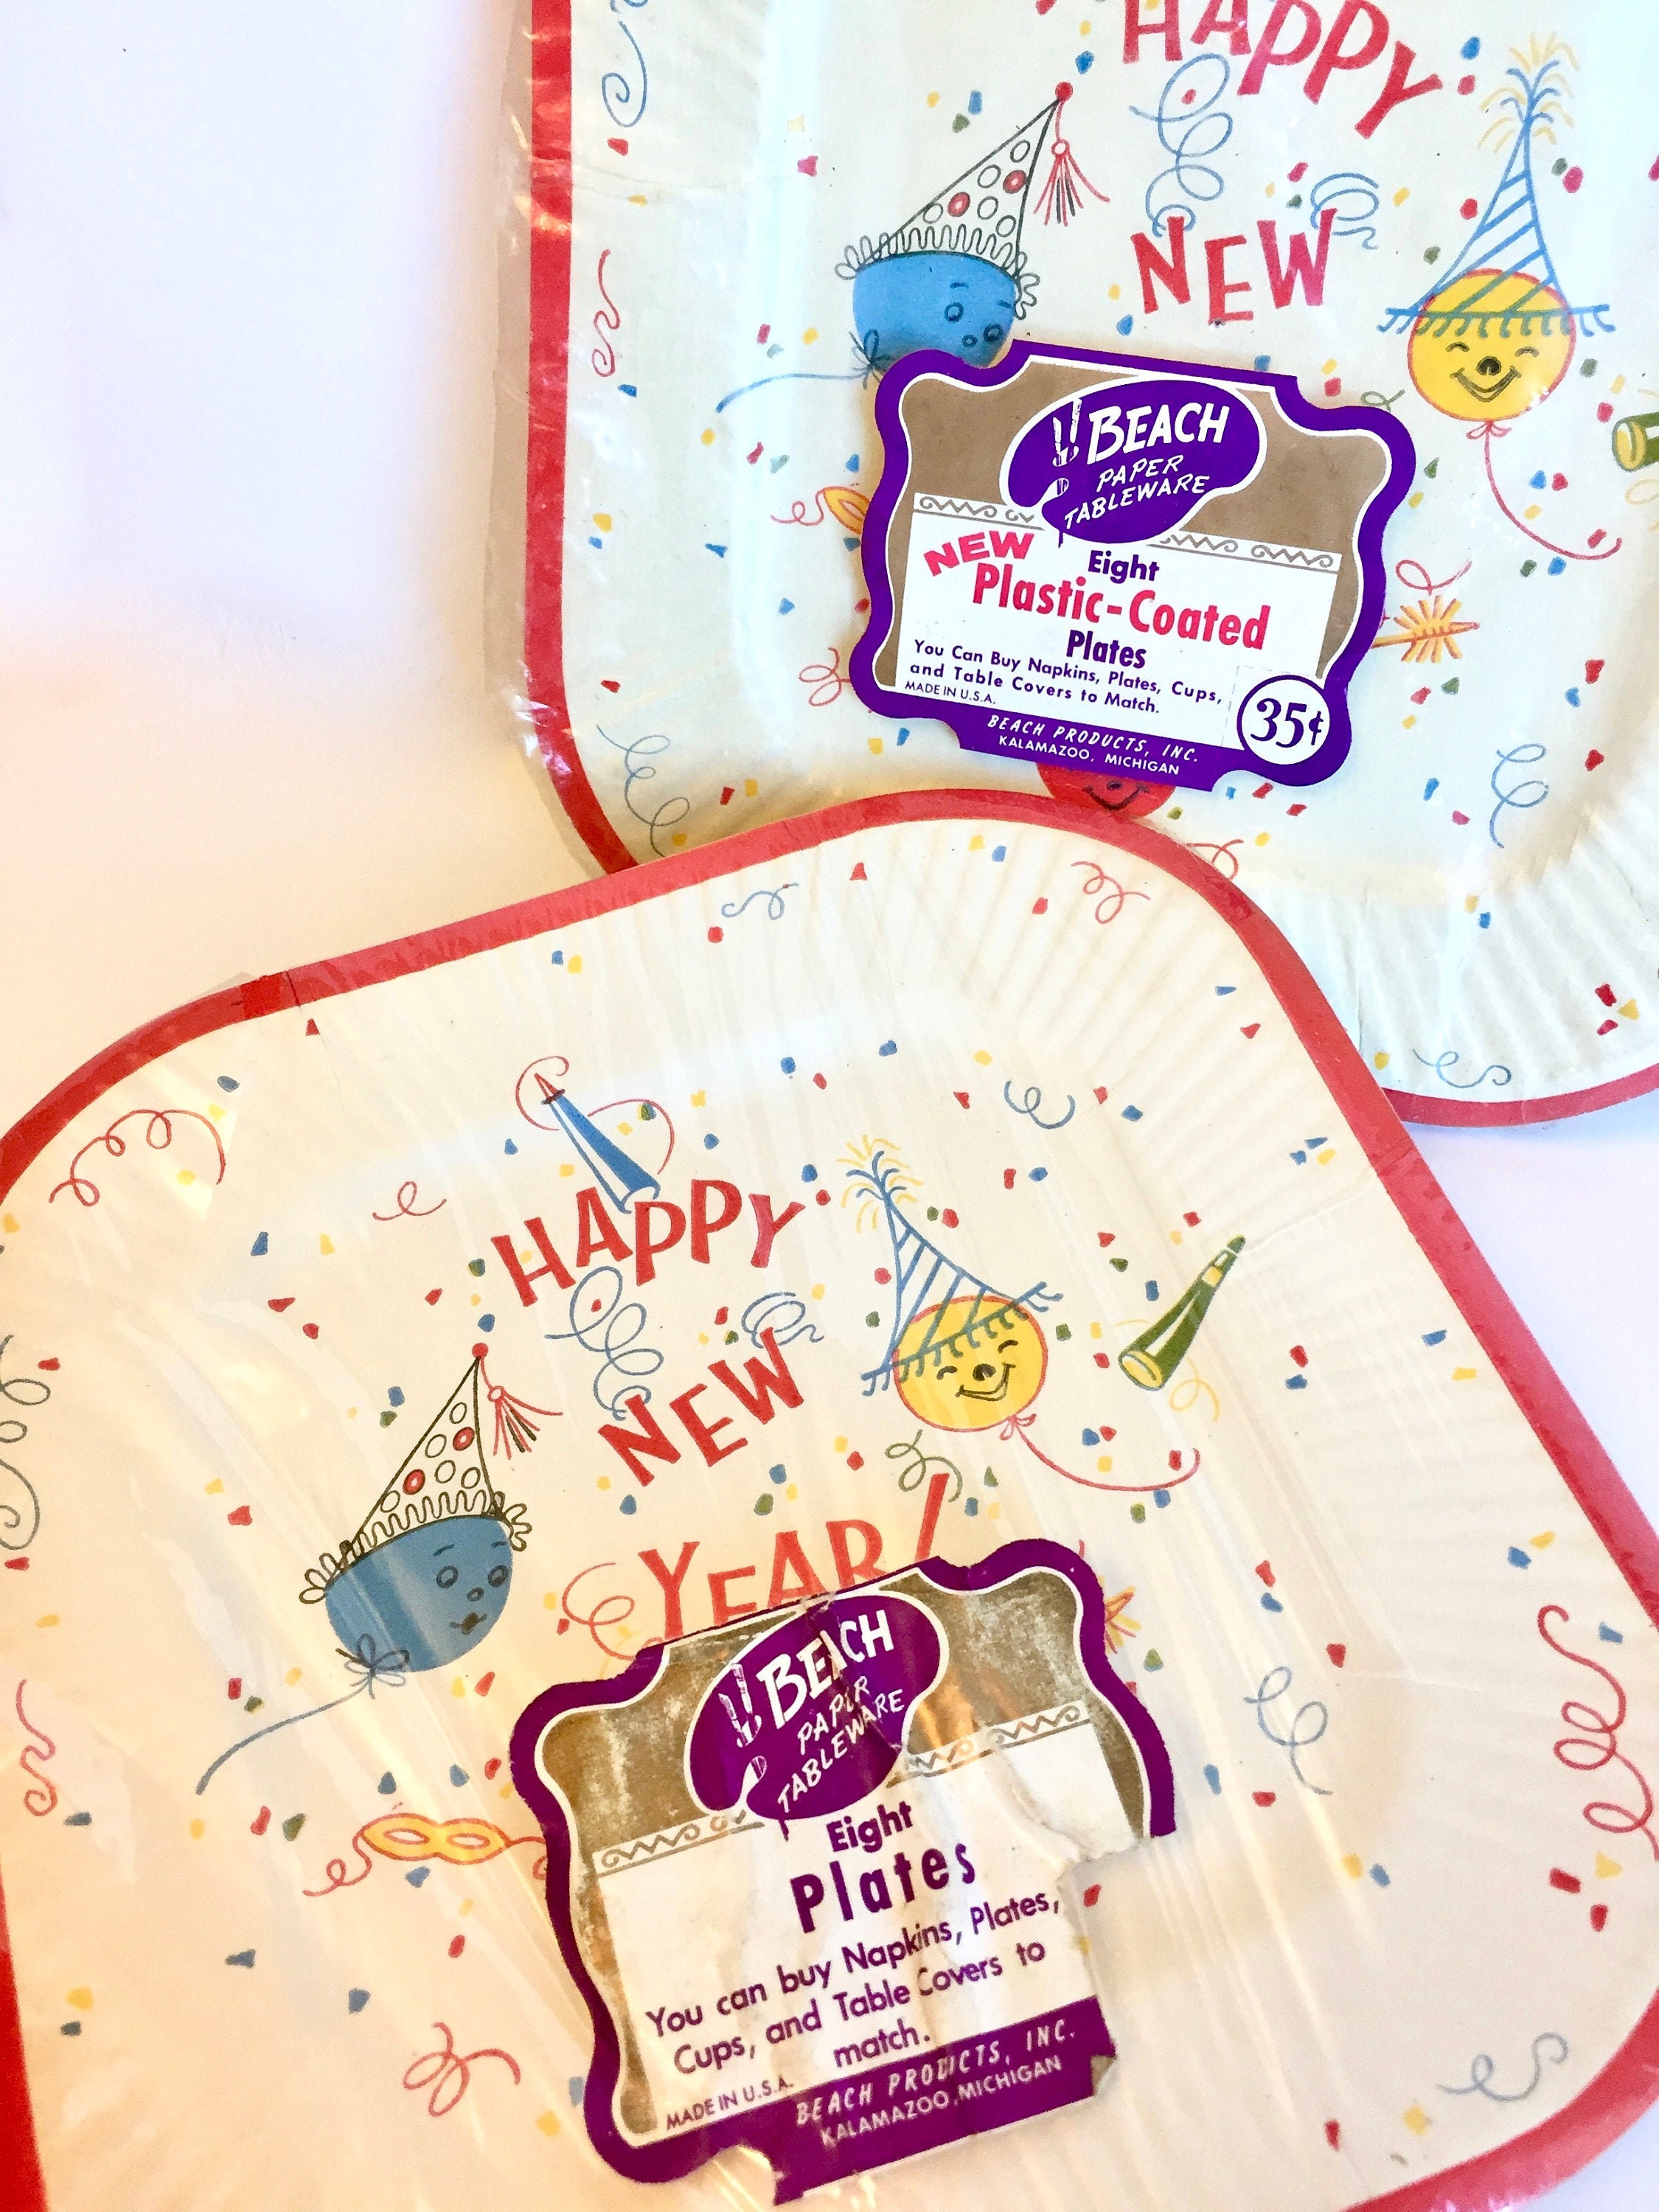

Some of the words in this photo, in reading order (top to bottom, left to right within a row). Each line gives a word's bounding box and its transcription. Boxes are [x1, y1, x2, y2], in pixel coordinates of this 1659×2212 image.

[1123, 0, 1442, 139] HAPPY
[1130, 208, 1337, 324] NEW
[1087, 403, 1230, 465] BEACH
[1065, 473, 1210, 529] TABLEWARE
[1096, 455, 1183, 493] PAPER
[923, 530, 1034, 577] NEW
[1088, 550, 1160, 584] Eight
[973, 562, 1271, 650] Plastic-Coated
[914, 639, 944, 656] You
[952, 645, 983, 663] Can
[991, 651, 1021, 672] Buy
[1028, 658, 1100, 685] Napkins,
[1108, 672, 1161, 695] Plates,
[1172, 681, 1222, 705] Cups,
[1066, 630, 1146, 669] Plates
[905, 681, 940, 695] MADE
[943, 686, 956, 697] IN
[960, 689, 996, 705] U.S.A.
[910, 663, 944, 678] and
[955, 667, 1003, 687] Table
[1012, 678, 1072, 700] Covers
[1082, 689, 1097, 703] to
[1105, 693, 1161, 714] Match.
[987, 714, 1045, 737] BEACH
[1053, 726, 1150, 757] PRODUCTS,
[1162, 743, 1198, 762] INC.
[1251, 697, 1324, 748] 35¢
[999, 735, 1094, 762] KALAMAZOO,
[1105, 753, 1179, 776] MICHIGAN
[491, 1179, 806, 1307] HAPPY
[597, 1327, 804, 1486] NEW
[777, 1688, 905, 1813] TABLEWARE
[827, 1799, 914, 1856] Eight
[789, 1843, 978, 1935] Plates
[645, 2007, 703, 2038] You
[716, 1983, 768, 2016] can
[776, 1961, 832, 1993] buy
[841, 1921, 961, 1974] Napkins,
[970, 1891, 1060, 1935] Plates,
[674, 2035, 756, 2074] Cups,
[766, 1998, 822, 2045] and
[832, 1979, 911, 2022] Table
[917, 1955, 1003, 1996] Covers
[1016, 1941, 1046, 1967] to
[833, 2018, 931, 2068] match.
[796, 2082, 873, 2127] BEACH
[1026, 2019, 1075, 2052] INC.
[820, 2090, 959, 2149] KALAMAZOO,
[958, 2055, 1062, 2100] MICHIGAN
[666, 2103, 715, 2130] MADE
[719, 2093, 738, 2112] IN
[743, 2076, 795, 2104] U.S.A.
